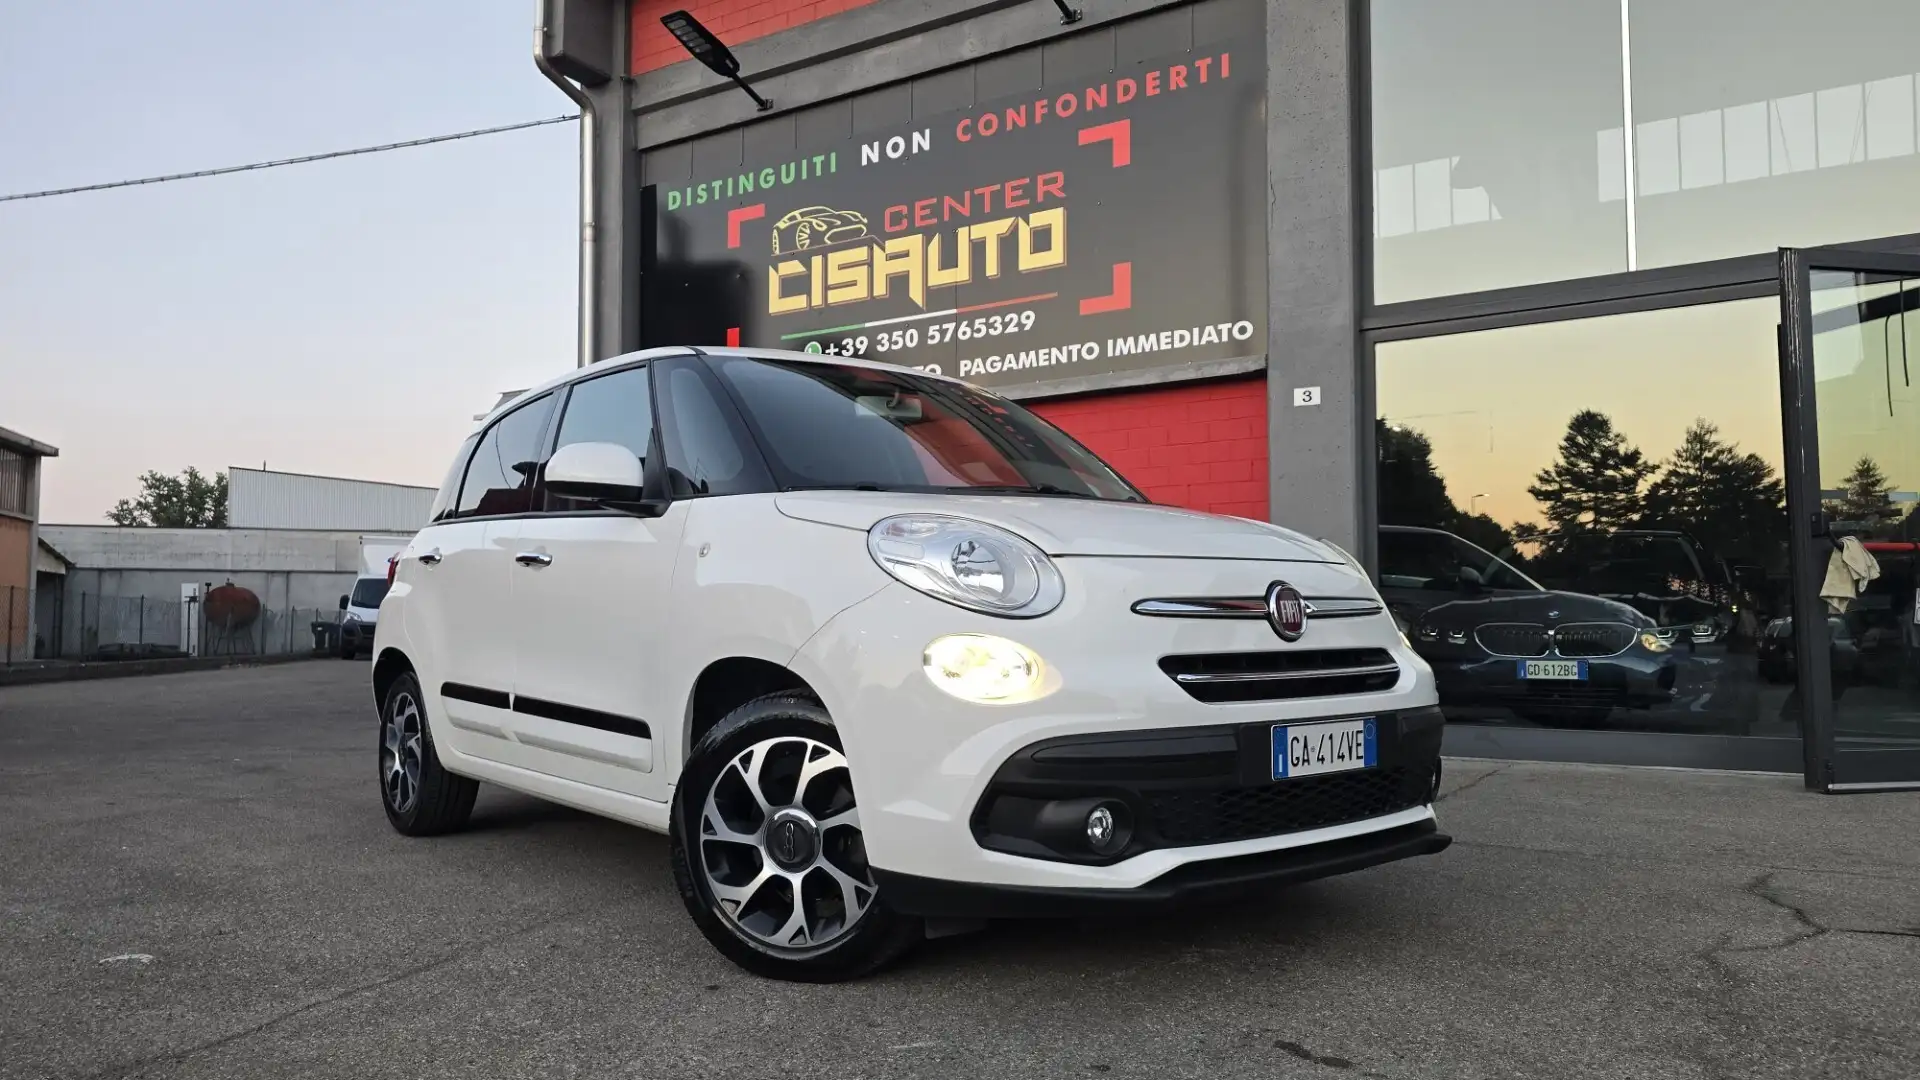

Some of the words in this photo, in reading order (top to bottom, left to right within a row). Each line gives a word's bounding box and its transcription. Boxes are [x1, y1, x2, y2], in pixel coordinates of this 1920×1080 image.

[667, 152, 837, 211] DISTINGUITI
[861, 128, 931, 166] NON
[956, 52, 1231, 142] CONFONDERTI
[884, 170, 1067, 233] CENTER
[768, 206, 1068, 316] CISAUTO
[876, 328, 919, 352] 350
[927, 310, 1036, 346] 5765329
[959, 342, 1100, 377] PAGAMENTO
[1107, 320, 1254, 358] IMMEDIATO
[1302, 390, 1312, 403] 3
[1280, 599, 1301, 624] FIAT
